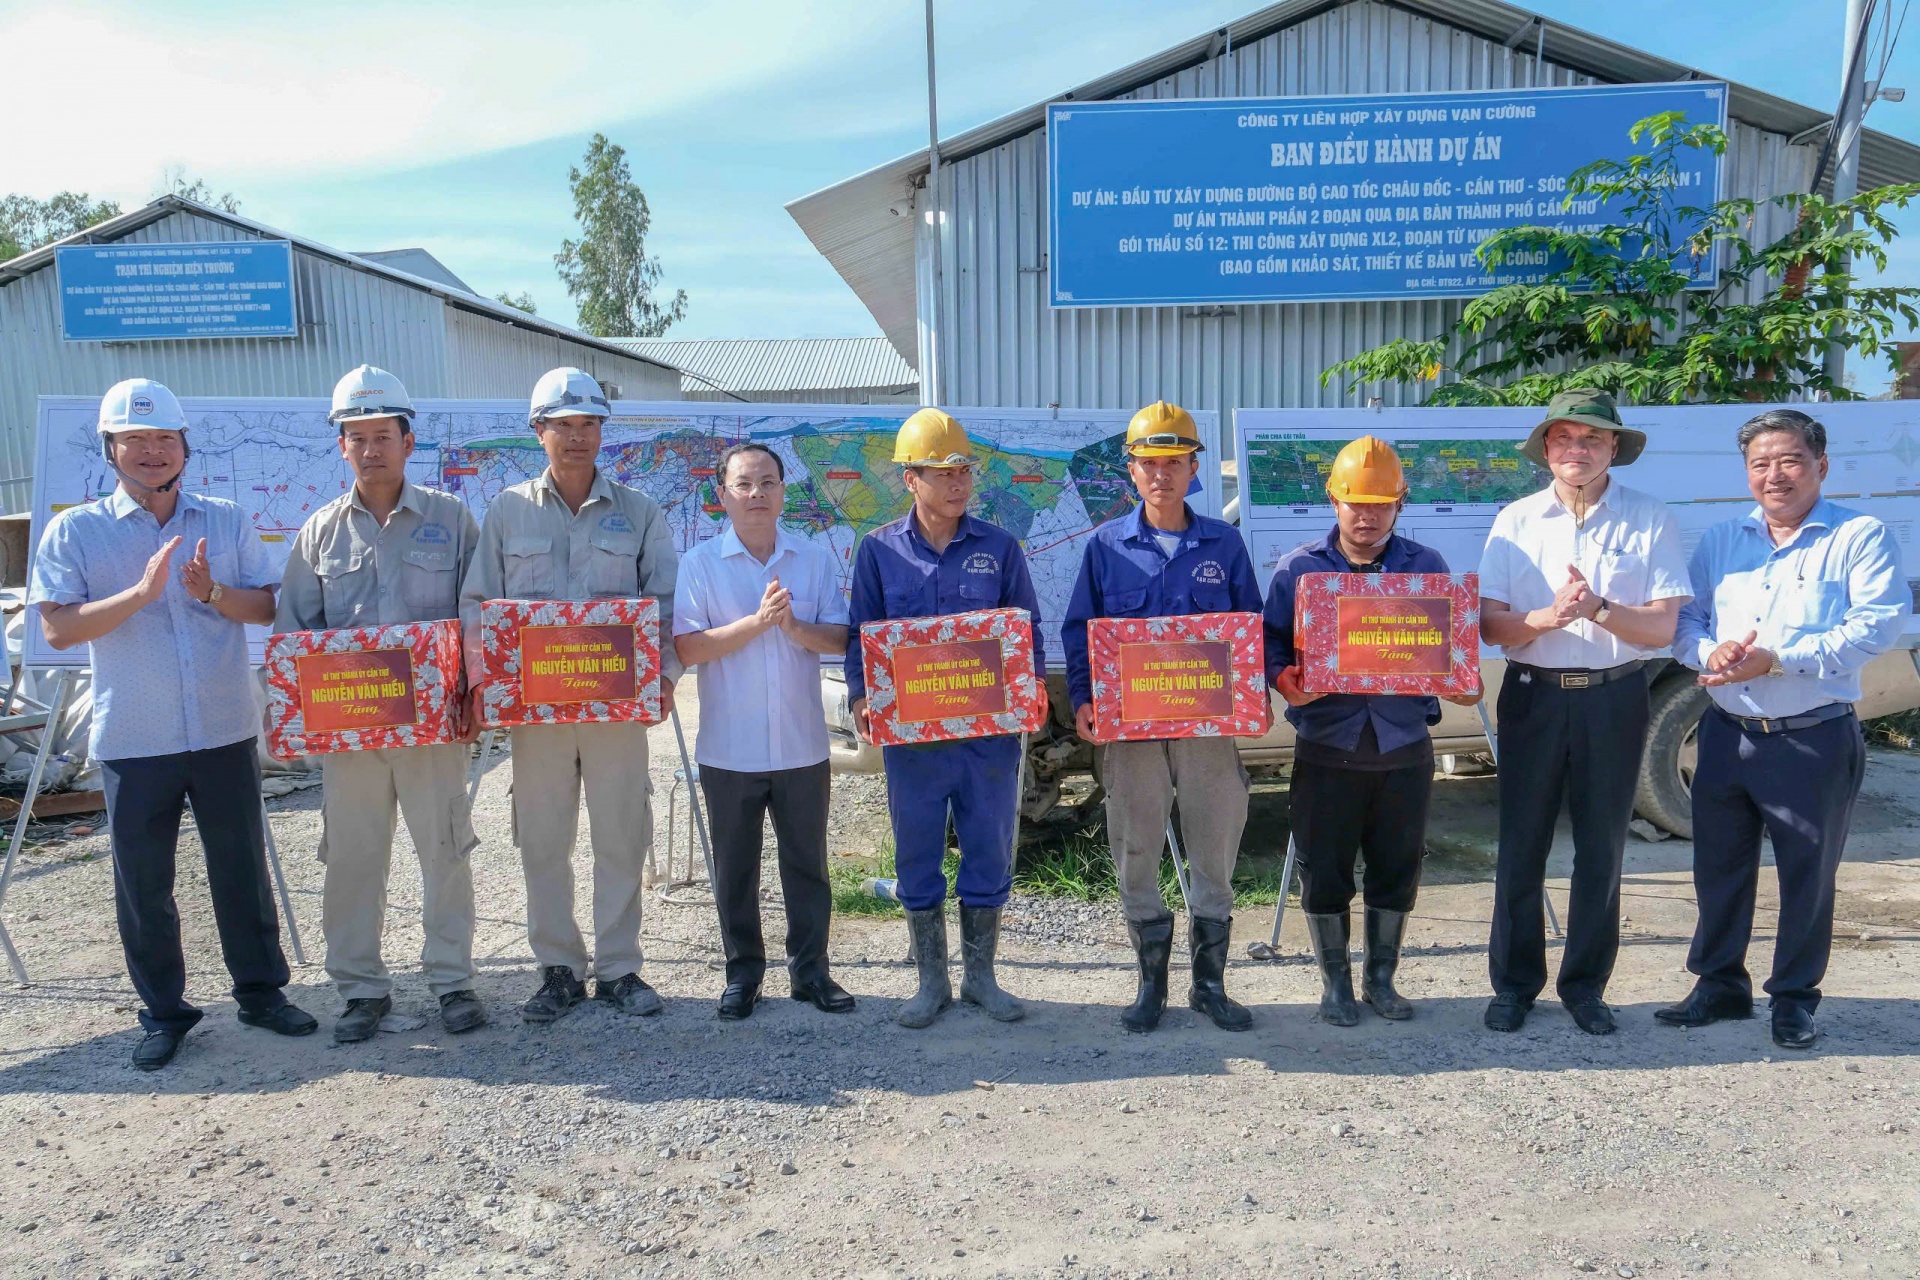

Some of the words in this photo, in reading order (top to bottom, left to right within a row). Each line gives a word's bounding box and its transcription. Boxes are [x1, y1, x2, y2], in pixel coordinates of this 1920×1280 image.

[1237, 112, 1278, 128] CÔNG
[1282, 113, 1299, 127] TY
[1303, 110, 1336, 126] LIÊN
[1340, 110, 1370, 127] HỢP
[1373, 108, 1403, 124] XÂY
[1406, 108, 1447, 125] DỰNG
[1451, 107, 1481, 124] VẠN
[1485, 103, 1537, 120] CƯỜNG
[1271, 142, 1314, 167] BAN
[1319, 131, 1369, 166] ĐIỀU
[1374, 133, 1434, 164] HÀNH
[1438, 136, 1469, 167] DỰ
[1472, 131, 1502, 161] ÁN
[1071, 190, 1093, 209] DỰ
[1094, 187, 1118, 206] ÁN:
[1121, 185, 1150, 205] ĐẦU
[1153, 188, 1172, 205] TƯ
[1173, 186, 1201, 204] XÂY
[1205, 187, 1243, 207] DỰNG
[1247, 183, 1295, 203] ĐƯỜNG
[1298, 182, 1317, 203] BỘ
[1321, 184, 1349, 200] CAO
[1352, 178, 1378, 199] TỐC
[1382, 179, 1420, 198] CHÂU
[1423, 176, 1452, 197] ĐỐC
[1465, 175, 1494, 196] CẦN
[1498, 177, 1525, 194] THƠ
[1537, 174, 1567, 193] SÓC
[1173, 211, 1194, 231] DỰ
[1196, 210, 1216, 228] ÁN
[1219, 208, 1265, 227] THÀNH
[1268, 205, 1307, 226] PHẦN
[1310, 209, 1320, 224] 2
[1323, 208, 1362, 226] ĐOẠN
[1365, 206, 1393, 223] QUA
[1396, 206, 1420, 225] ĐỊA
[1423, 203, 1453, 221] BÀN
[1456, 201, 1502, 220] THÀNH
[1505, 197, 1534, 218] PHỐ
[1537, 196, 1570, 217] CẦN
[1571, 197, 1598, 215] THƠ
[1118, 235, 1143, 253] GÓI
[1146, 232, 1181, 253] THẦU
[1184, 231, 1205, 252] SỐ
[1207, 236, 1229, 251] 12:
[1232, 235, 1254, 251] THI
[1257, 233, 1295, 250] CÔNG
[1299, 231, 1326, 249] XÂY
[1329, 231, 1368, 251] DỰNG
[1372, 231, 1401, 248] XL2,
[1404, 230, 1444, 248] ĐOẠN
[1447, 226, 1467, 244] TỪ
[1220, 259, 1251, 276] (BAO
[1256, 254, 1288, 274] GỒM
[1292, 253, 1329, 273] KHẢO
[1332, 254, 1361, 273] SÁT,
[1364, 251, 1402, 271] THIẾT
[1405, 250, 1425, 270] KẾ
[1427, 249, 1456, 269] BẢN
[1506, 248, 1549, 267] CÔNG)
[1406, 278, 1420, 290] ĐỊA
[1361, 615, 1368, 624] BÍ
[1368, 616, 1379, 624] THƯ
[1379, 615, 1397, 624] THÀNH
[1405, 613, 1417, 624] CẦN
[1417, 615, 1428, 624] THƠ
[1348, 626, 1391, 646] NGUYỄN
[1393, 628, 1415, 646] VĂN
[1417, 626, 1443, 646] HIẾU
[545, 645, 551, 654] BÍ
[552, 644, 562, 653] THƯ
[563, 643, 580, 653] THÀNH
[589, 642, 601, 652] CẦN
[601, 642, 612, 651] THƠ
[1376, 648, 1414, 661] Tặng
[532, 655, 575, 676] NGUYỄN
[577, 656, 599, 674] VĂN
[602, 653, 627, 673] HIẾU
[916, 664, 923, 673] BÍ
[923, 663, 934, 672] THƯ
[934, 661, 951, 671] THÀNH
[958, 658, 970, 668] CẦN
[970, 658, 981, 667] THƠ
[1143, 662, 1150, 671] BÍ
[1150, 661, 1161, 670] THƯ
[1161, 660, 1179, 670] THÀNH
[1186, 658, 1198, 669] CẦN
[1198, 659, 1209, 668] THƠ
[323, 671, 330, 681] BÍ
[330, 671, 341, 681] THƯ
[341, 670, 359, 680] THÀNH
[367, 667, 378, 678] CẦN
[379, 667, 390, 677] THƠ
[905, 672, 947, 694] NGUYỄN
[948, 672, 970, 690] VĂN
[971, 668, 996, 688] HIẾU
[1131, 671, 1173, 692] NGUYỄN
[1175, 673, 1197, 690] VĂN
[1199, 670, 1224, 689] HIẾU
[311, 682, 355, 704] NGUYỄN
[356, 682, 379, 700] VĂN
[381, 678, 406, 698] HIẾU
[560, 677, 598, 690] Tặng
[934, 694, 970, 706] Tặng
[1160, 694, 1196, 706] Tặng
[340, 704, 379, 716] Tặng
